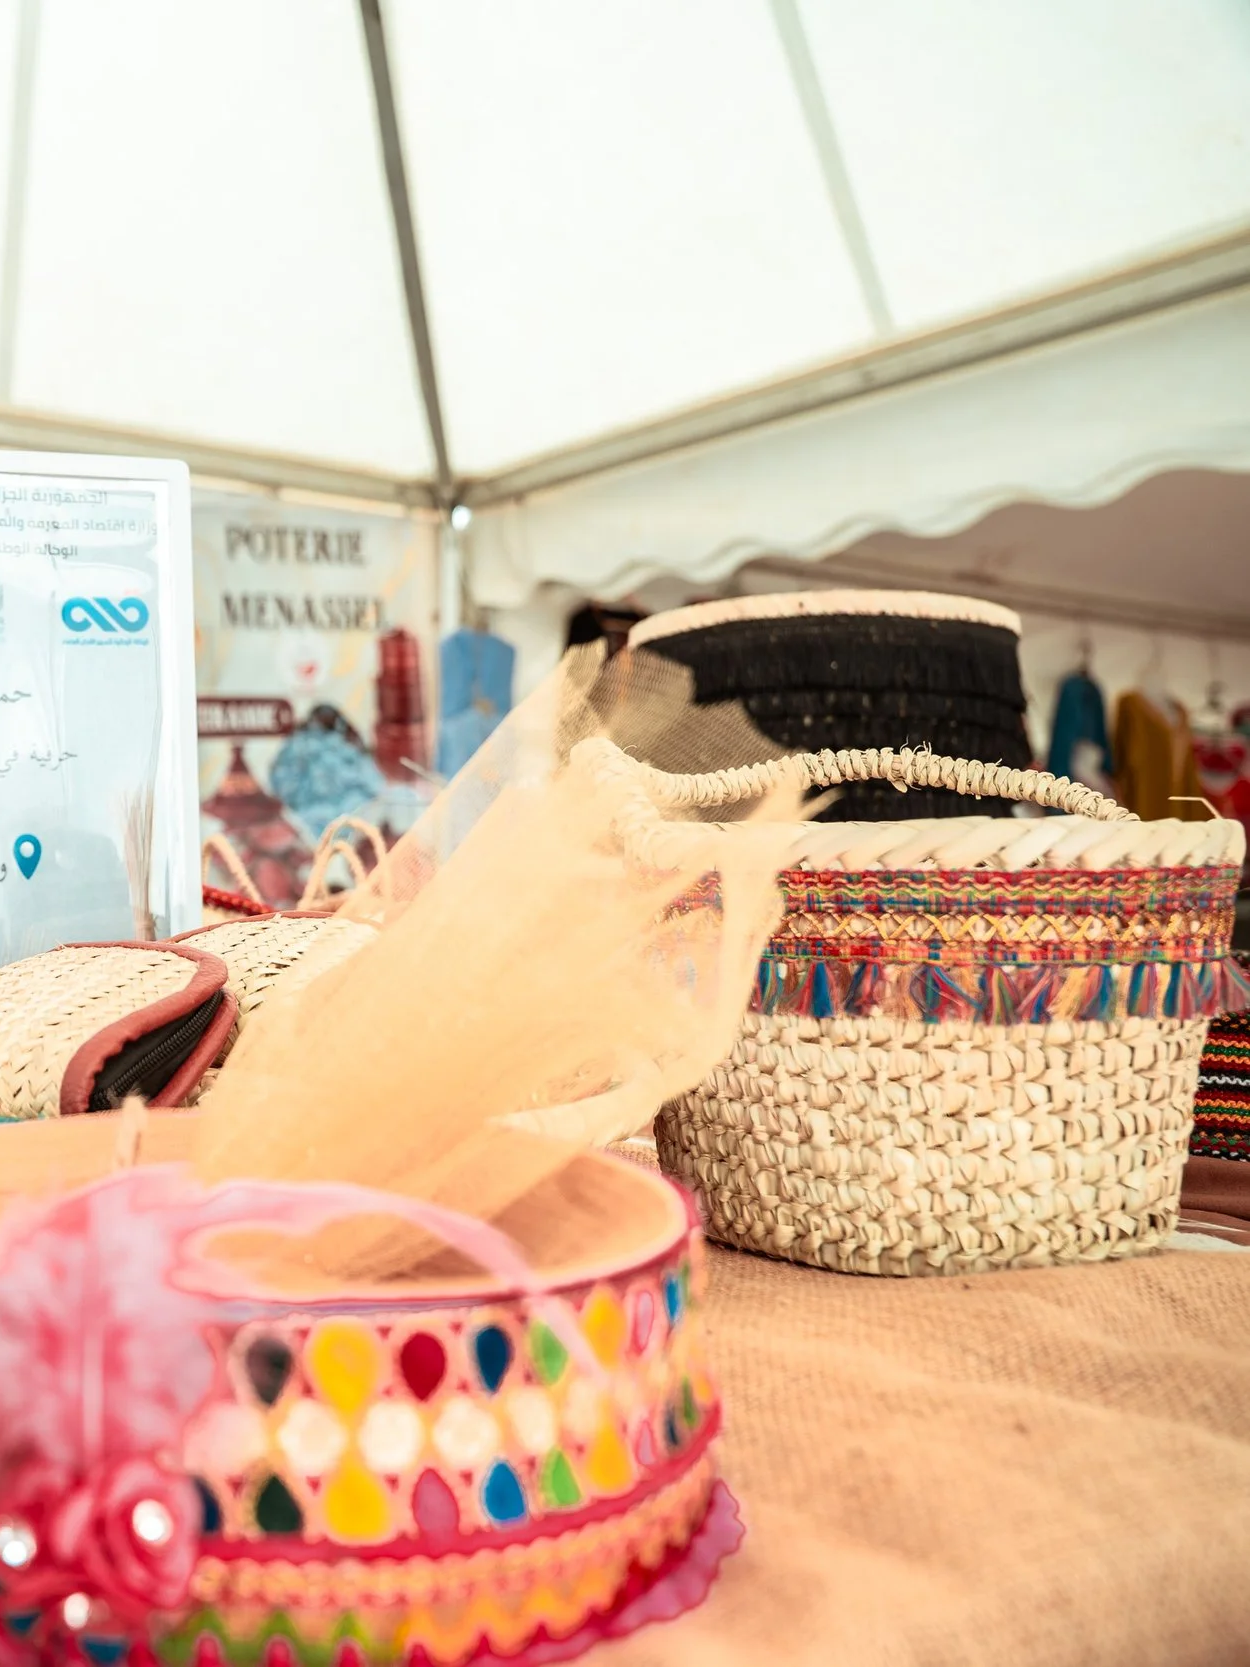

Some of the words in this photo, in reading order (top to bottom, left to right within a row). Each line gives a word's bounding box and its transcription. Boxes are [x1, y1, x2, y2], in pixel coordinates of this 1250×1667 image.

[31, 489, 108, 508] الجمهورية
[224, 524, 367, 566] POTERIE
[29, 742, 79, 772] حرفية
